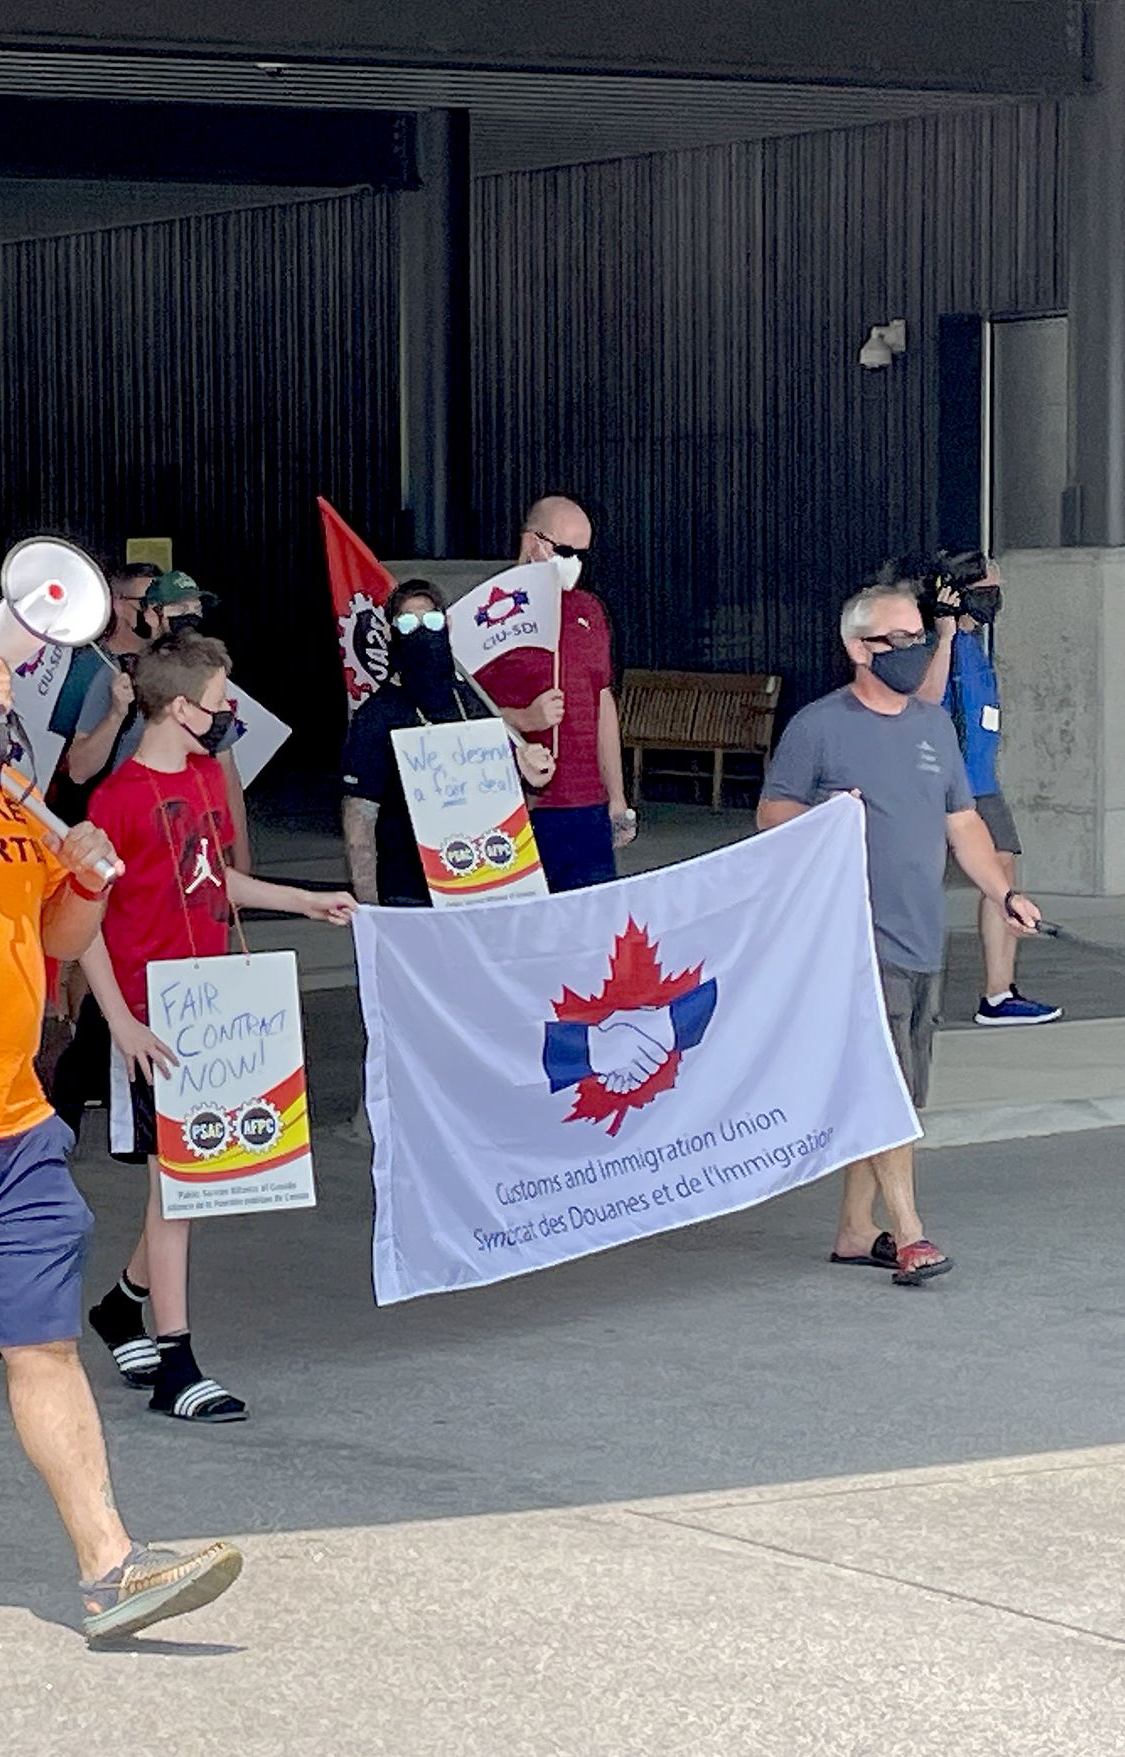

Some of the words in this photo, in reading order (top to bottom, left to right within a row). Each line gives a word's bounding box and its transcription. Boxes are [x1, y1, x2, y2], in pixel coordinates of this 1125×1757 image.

[401, 735, 438, 772] We
[160, 981, 221, 1030] FAIR
[180, 1039, 266, 1096] NOW!
[192, 1121, 224, 1140] PSAC
[496, 1173, 562, 1206] Customs
[564, 1159, 597, 1189] and
[719, 1107, 787, 1142] Union
[539, 1213, 568, 1238] des
[567, 1191, 650, 1230] Douanes
[651, 1183, 675, 1206] et
[675, 1174, 703, 1198] de
